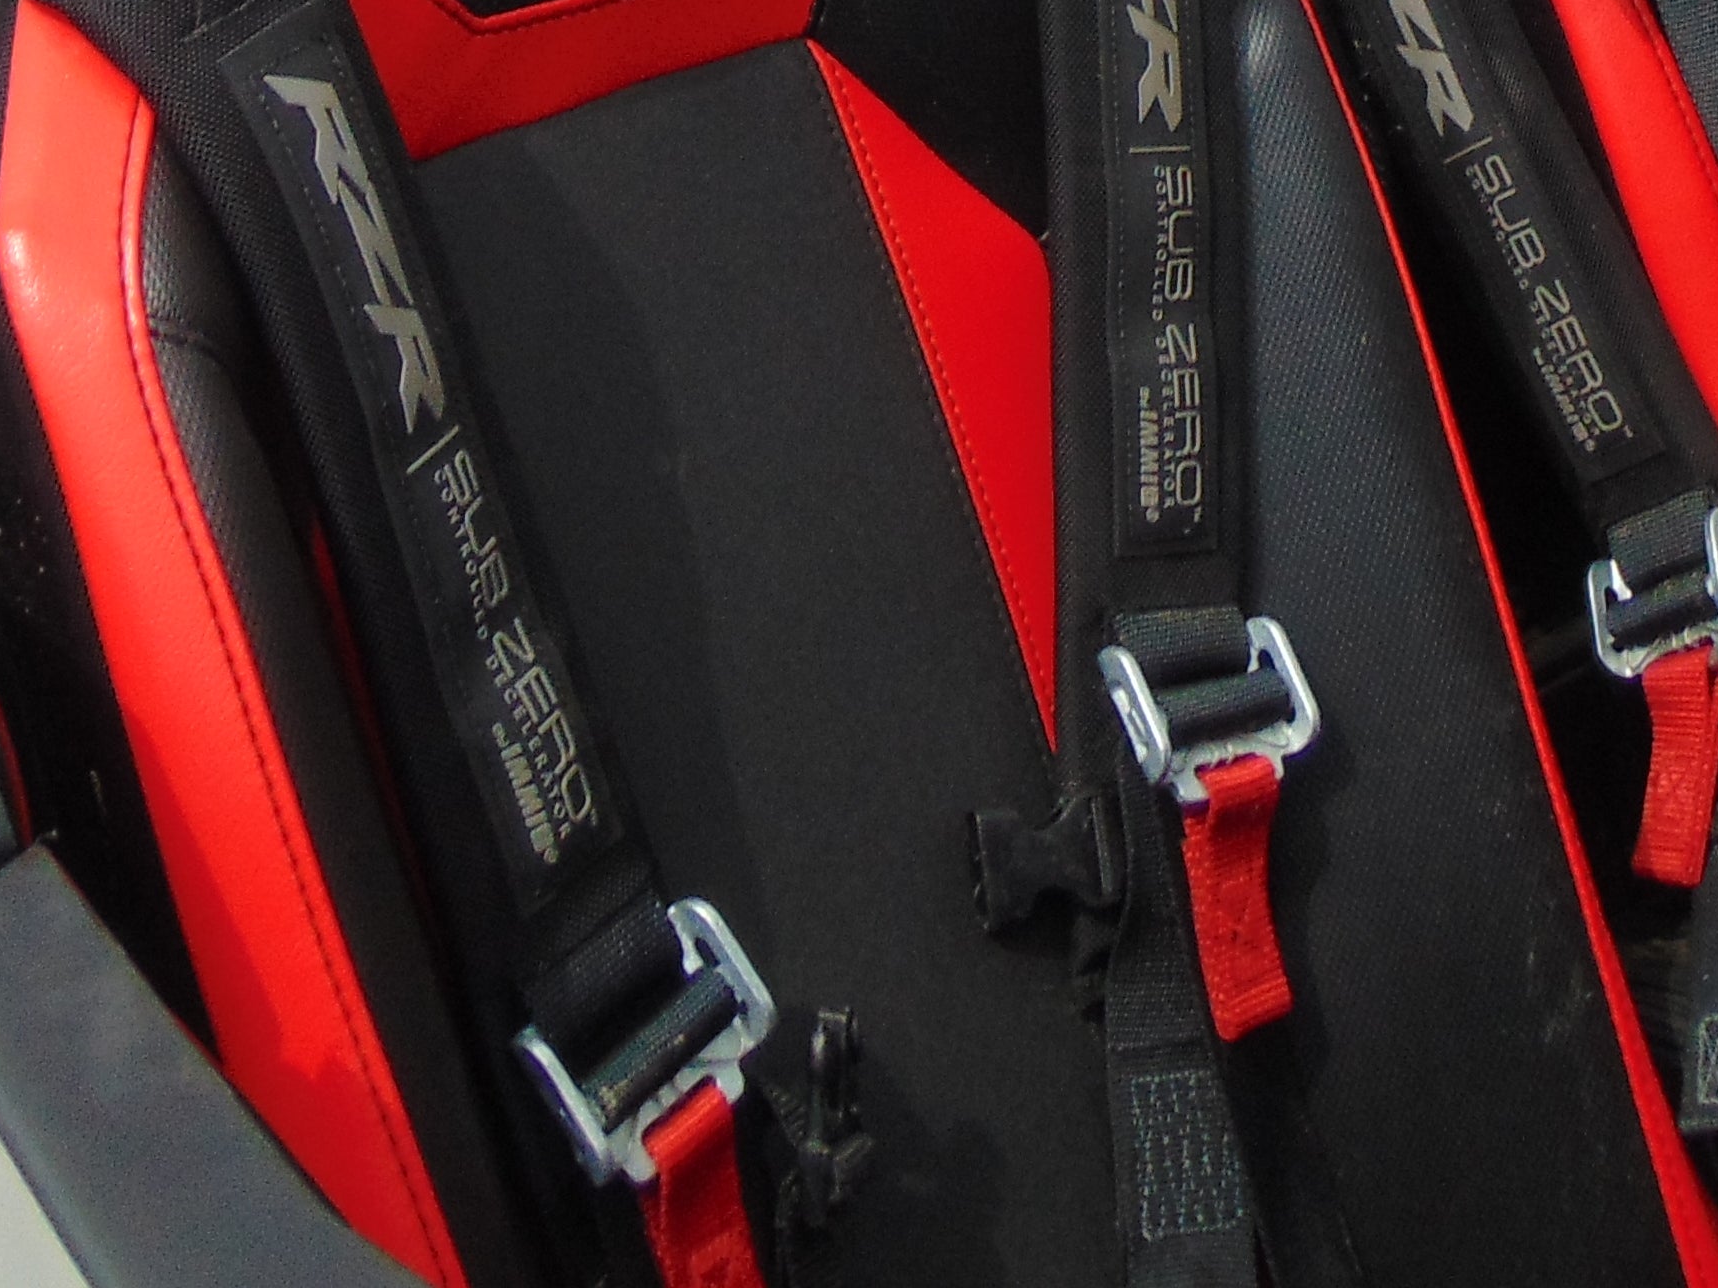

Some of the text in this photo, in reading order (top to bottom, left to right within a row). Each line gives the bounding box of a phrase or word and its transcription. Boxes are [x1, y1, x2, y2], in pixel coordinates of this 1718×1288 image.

[263, 74, 445, 434] RZR
[1165, 165, 1202, 508] SUB ZERO
[1473, 155, 1623, 432] SUB ZERO
[444, 450, 592, 823] SUB ZERO
